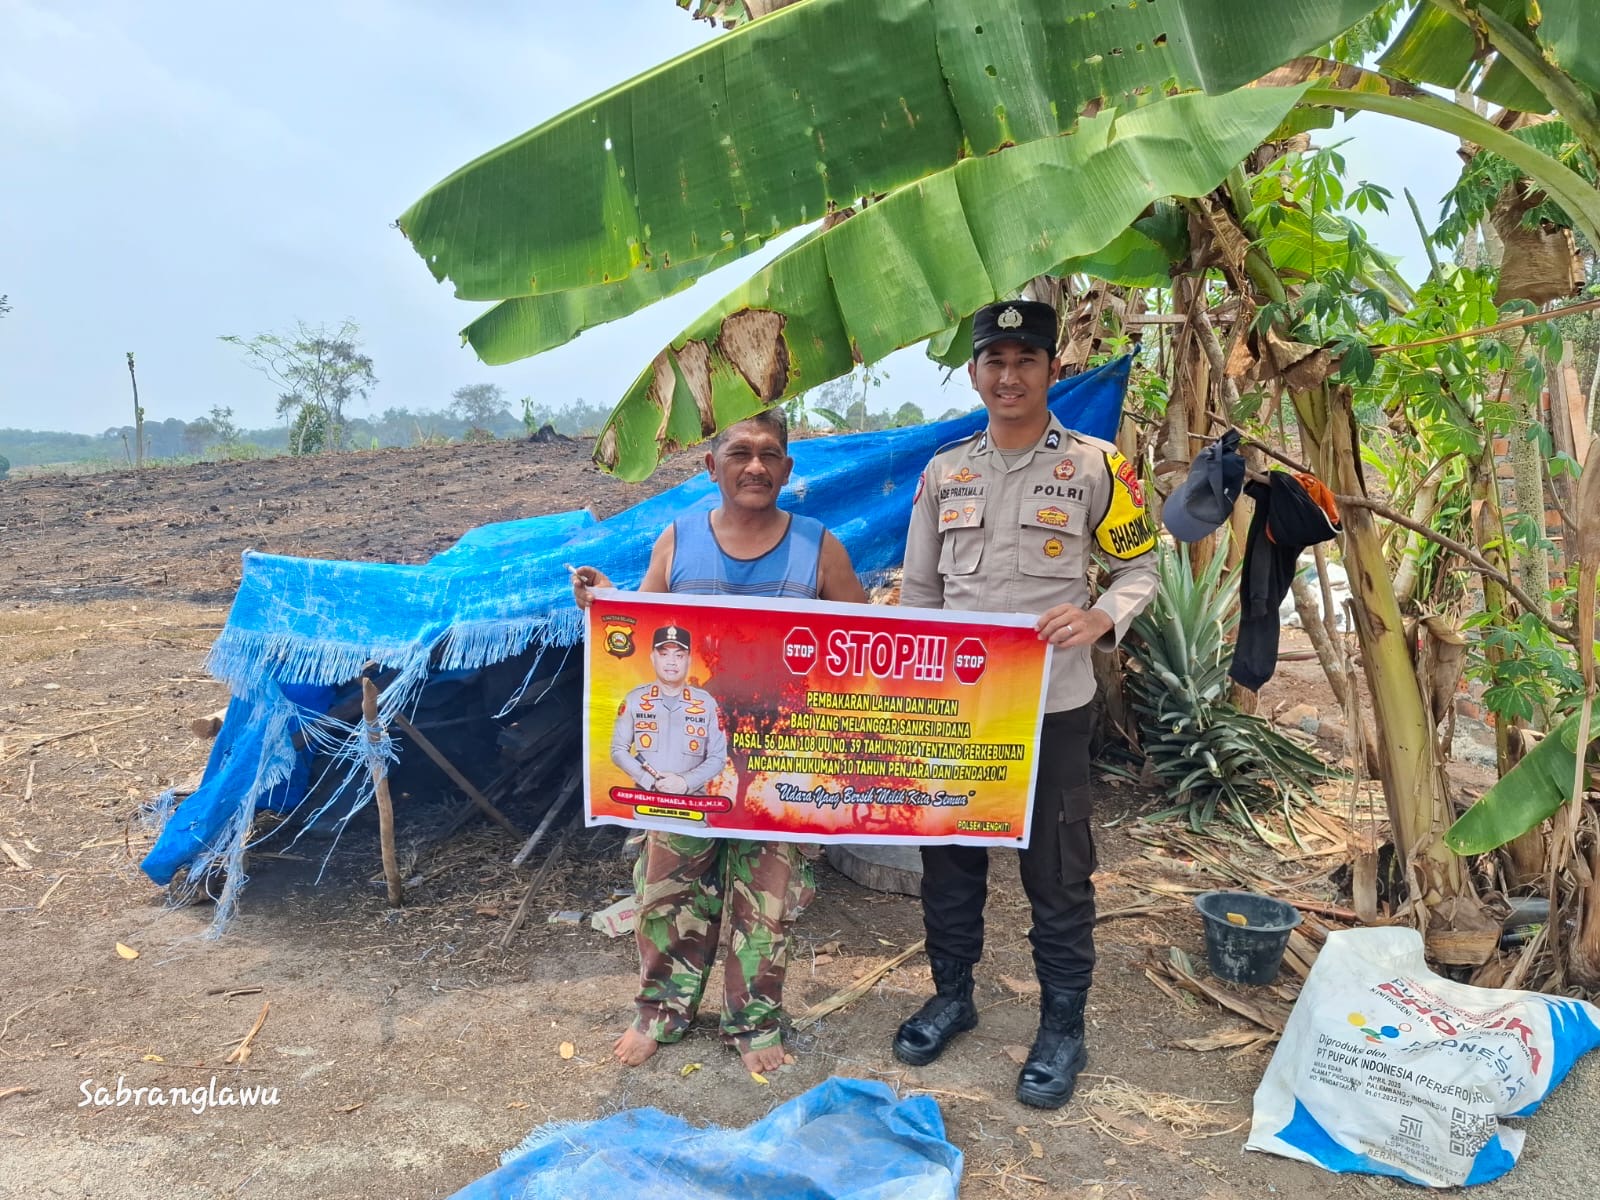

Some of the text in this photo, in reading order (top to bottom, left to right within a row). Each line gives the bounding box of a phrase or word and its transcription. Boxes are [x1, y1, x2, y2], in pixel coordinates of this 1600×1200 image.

[979, 487, 984, 496] A
[1033, 485, 1084, 501] POLRI
[786, 644, 814, 658] STOP
[826, 629, 947, 681] STOP!!!
[956, 655, 984, 668] STOP
[806, 691, 959, 716] PEMBAKARAN LAHAN DAN HUTAN
[790, 713, 971, 738] BAGI YANG MELANGGAR SANKSI PIDANA
[733, 732, 1024, 760] PASAL 56 DAN 108 UU NO. 39 TAHUN 2014 TENTANG PERKEBUNAN
[747, 755, 1007, 781] ANCAMAN HUKUMAN 10 TAHUN PENJARA DAN DENDA 10 M
[812, 790, 840, 808] Yang
[843, 786, 874, 804] Bersih
[876, 788, 904, 804] Milik
[907, 790, 930, 805] Kita
[957, 821, 982, 831] POLSEK
[1312, 1068, 1331, 1076] ALAMAT
[1317, 1048, 1327, 1058] PT
[1328, 1050, 1358, 1067] PUPUK
[1361, 1059, 1413, 1082] INDONESIA
[1415, 1074, 1472, 1105] (PERSERO)
[1398, 1118, 1423, 1138] SNI
